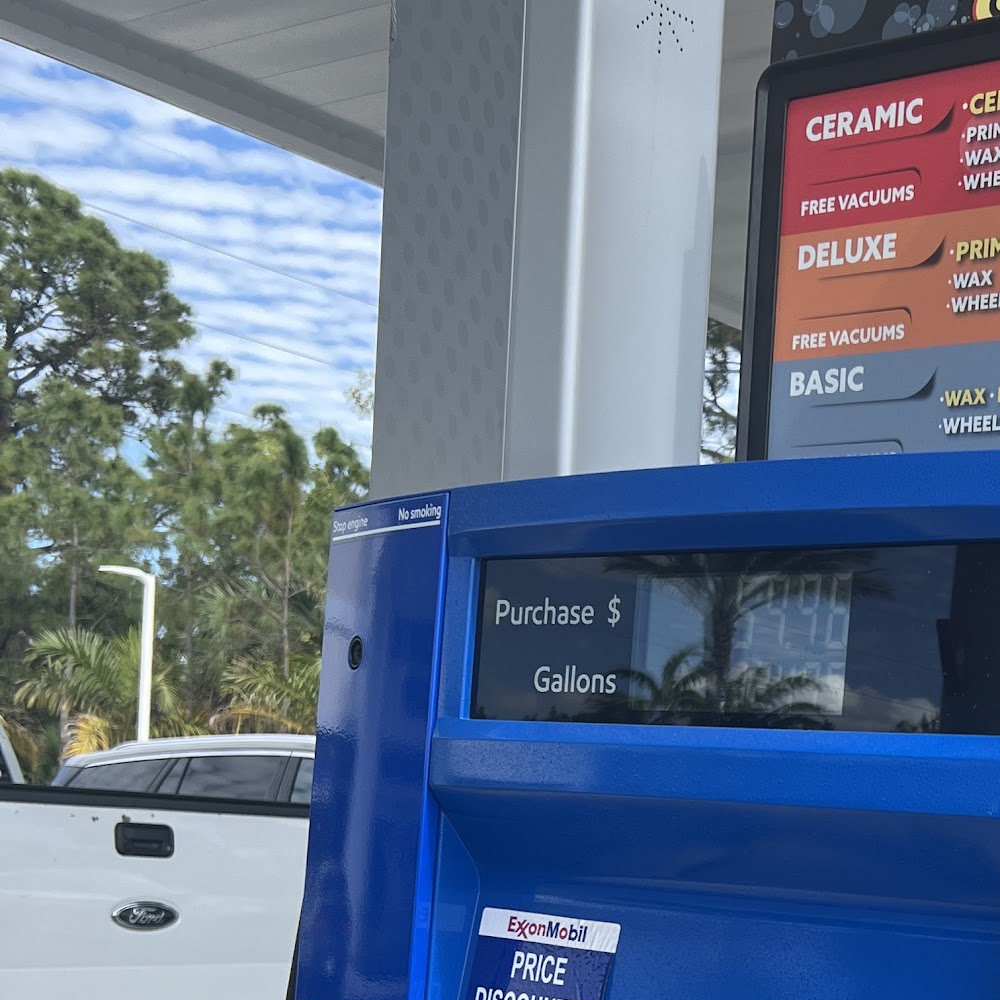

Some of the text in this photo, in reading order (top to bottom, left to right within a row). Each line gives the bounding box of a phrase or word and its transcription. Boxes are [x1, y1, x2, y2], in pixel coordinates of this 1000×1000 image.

[806, 98, 924, 142] CERAMIC
[801, 184, 915, 217] FREE VACUUMS
[797, 233, 897, 271] DELUXE
[953, 269, 993, 289] WAX
[792, 324, 905, 350] FREE VACUUMS
[789, 366, 864, 397] BASIC
[944, 388, 986, 407] WAX
[943, 414, 1000, 435] WHEEL
[333, 516, 369, 533] Stop engine
[398, 503, 442, 521] No smoking
[495, 594, 621, 628] Purchase $
[533, 664, 617, 695] Gallons
[129, 907, 166, 924] Ford
[507, 915, 588, 944] ExxonMobil
[510, 950, 568, 986] PRICE
